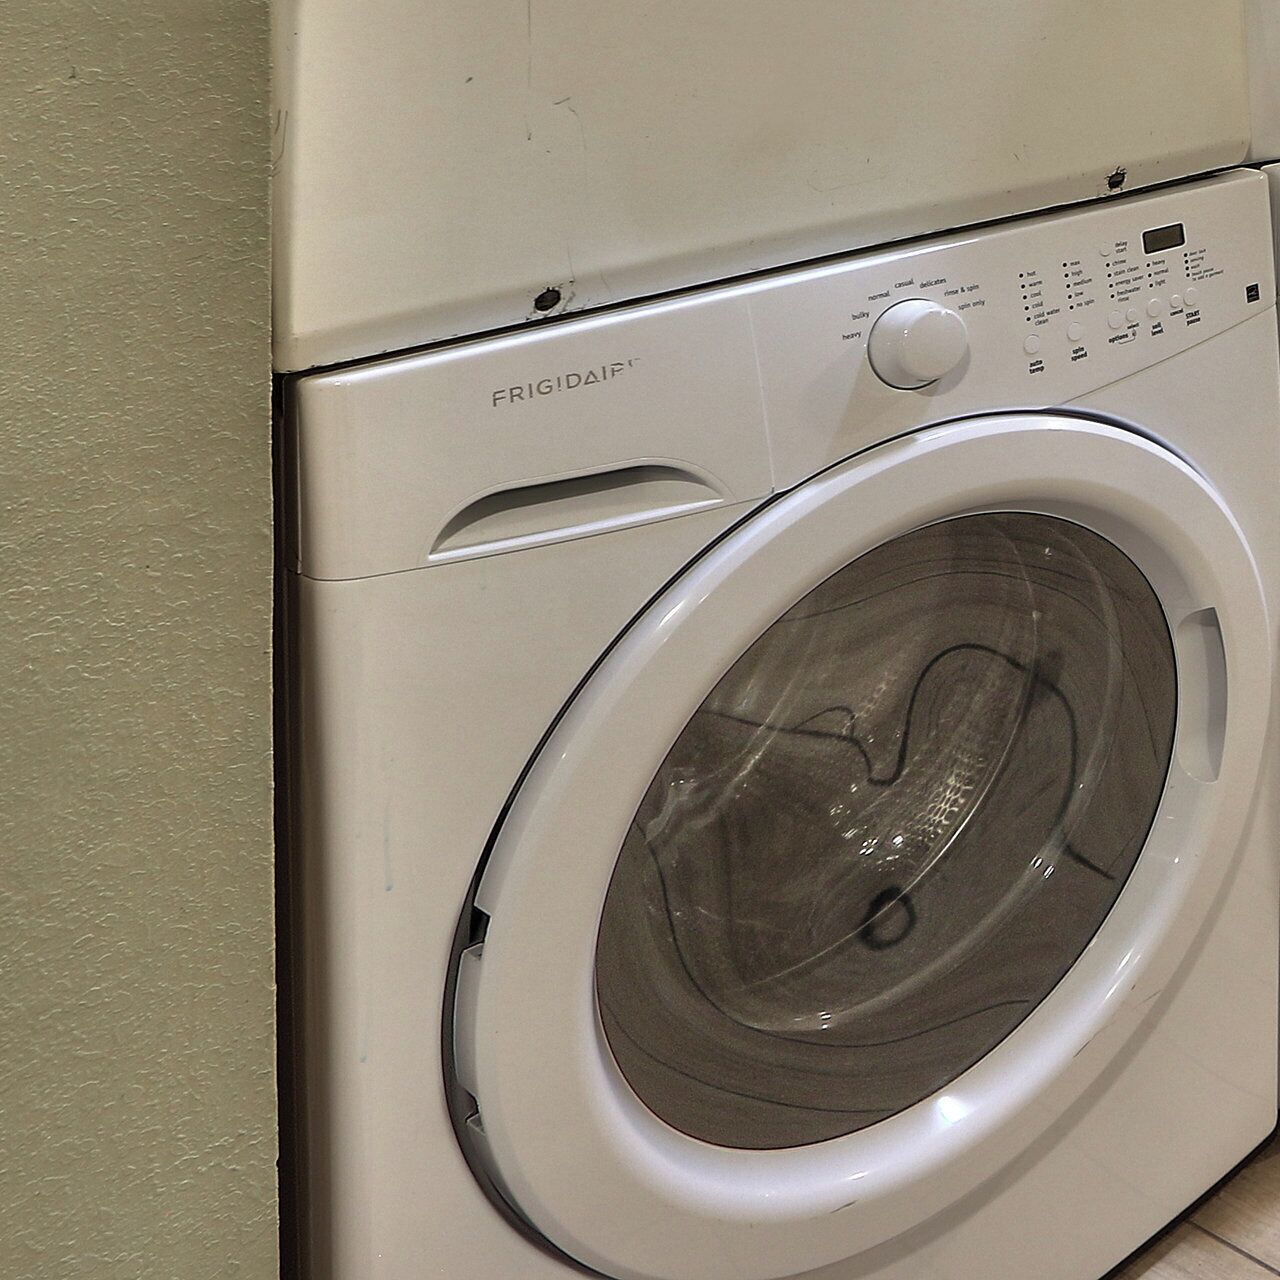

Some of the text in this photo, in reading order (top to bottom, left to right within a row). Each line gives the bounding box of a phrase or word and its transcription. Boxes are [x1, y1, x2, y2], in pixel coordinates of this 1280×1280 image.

[894, 278, 914, 288] casual
[920, 278, 946, 289] delicates
[1073, 278, 1092, 287] medium
[1115, 278, 1130, 287] energy
[944, 288, 959, 296] rinse
[966, 284, 979, 292] spin
[868, 290, 890, 301] normal
[958, 298, 985, 310] spin only
[852, 311, 870, 320] bulky
[842, 330, 861, 341] heavy
[1108, 333, 1128, 344] options
[1072, 346, 1084, 354] spin
[1071, 352, 1088, 362] speed
[1029, 366, 1044, 374] temp
[492, 358, 640, 407] FRIGIDAIR
